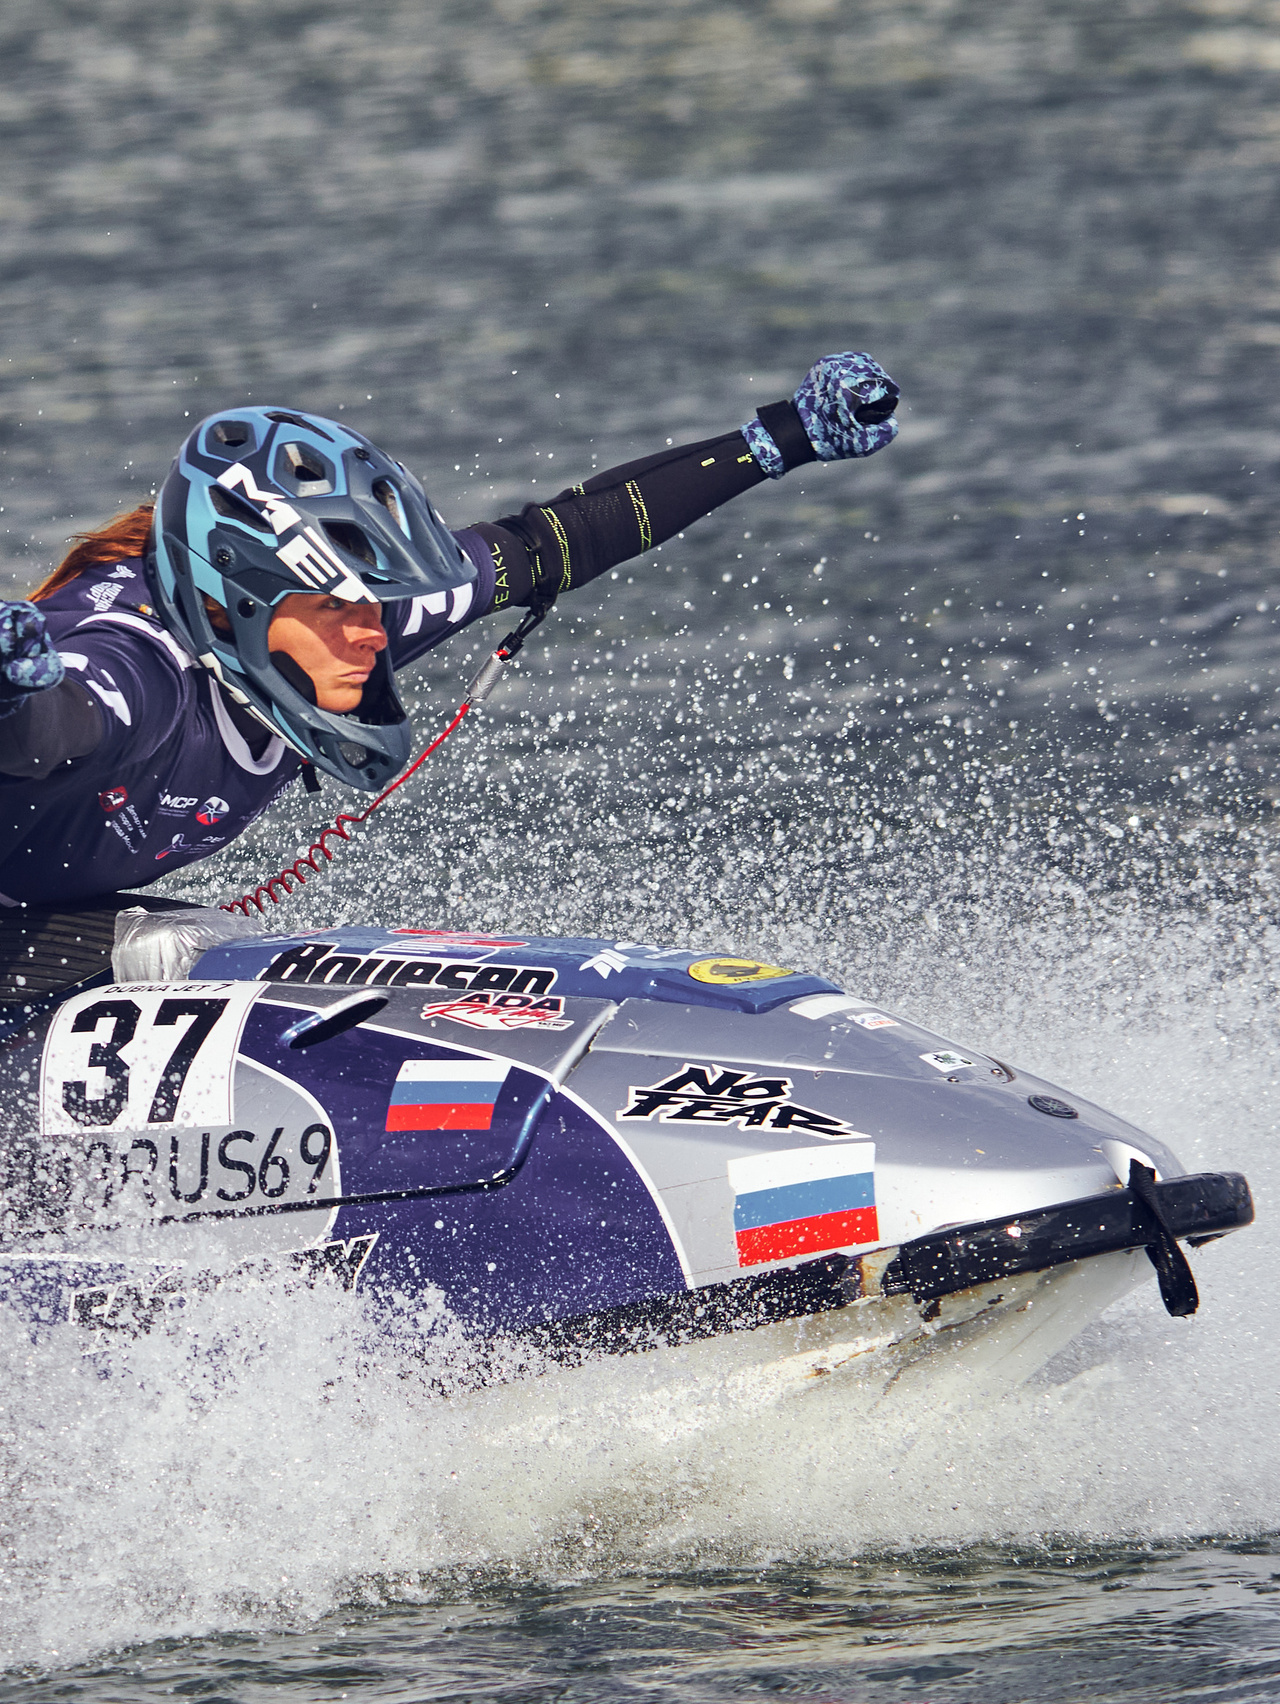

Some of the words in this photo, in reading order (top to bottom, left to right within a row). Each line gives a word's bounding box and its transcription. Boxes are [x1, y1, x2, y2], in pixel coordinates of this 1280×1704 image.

[103, 985, 170, 994] DUBNA
[172, 984, 211, 992] JET
[213, 983, 234, 992] 7
[62, 998, 232, 1127] 37
[621, 1089, 852, 1137] FEAR
